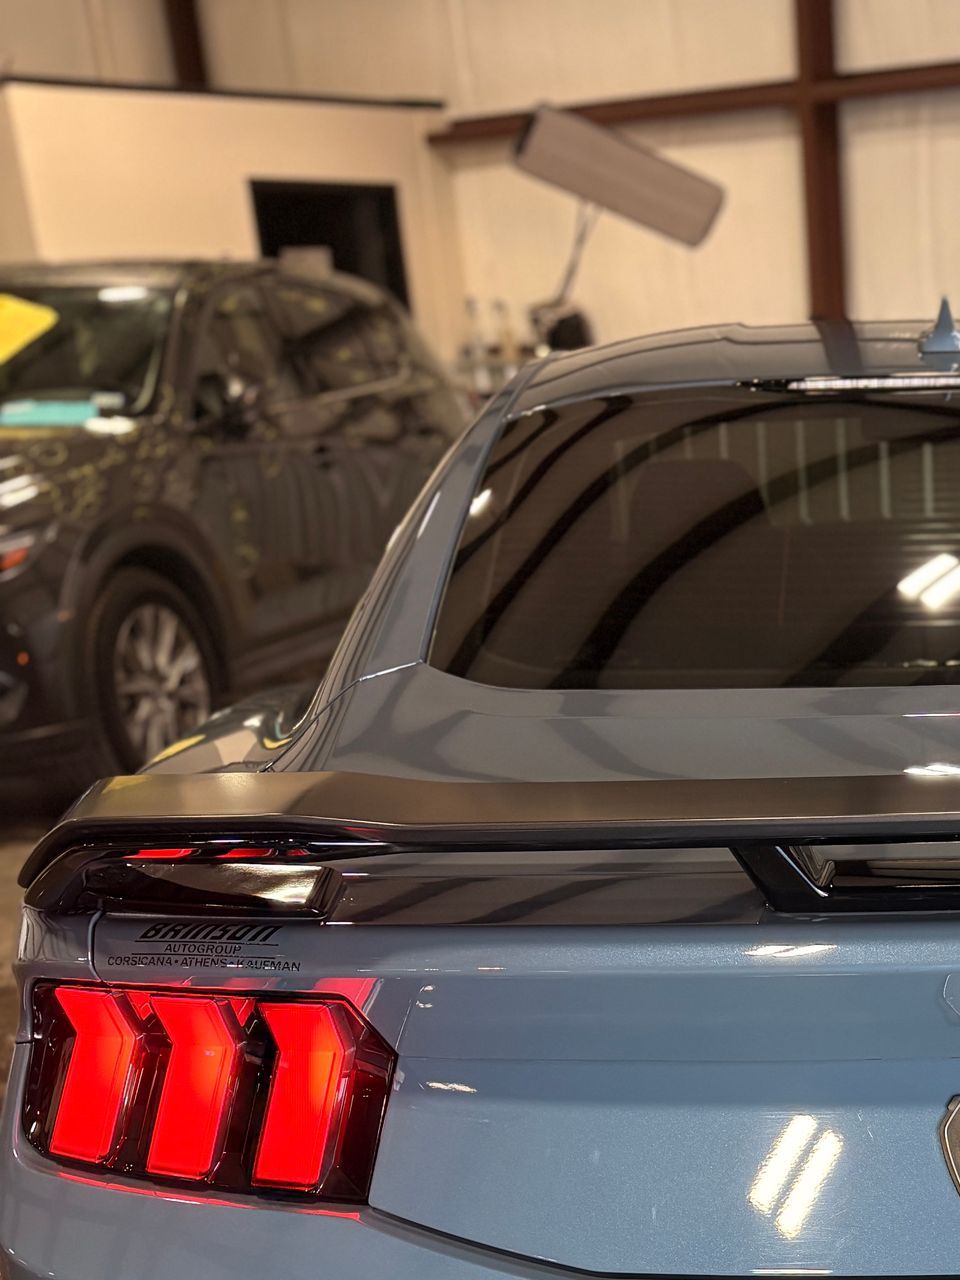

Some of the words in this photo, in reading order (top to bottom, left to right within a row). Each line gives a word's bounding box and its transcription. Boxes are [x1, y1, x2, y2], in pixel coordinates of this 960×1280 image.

[138, 922, 284, 942] BRINSON
[164, 943, 242, 955] AUTOGROUP
[107, 956, 173, 967] CORSICANA
[180, 957, 228, 968] ATHENS
